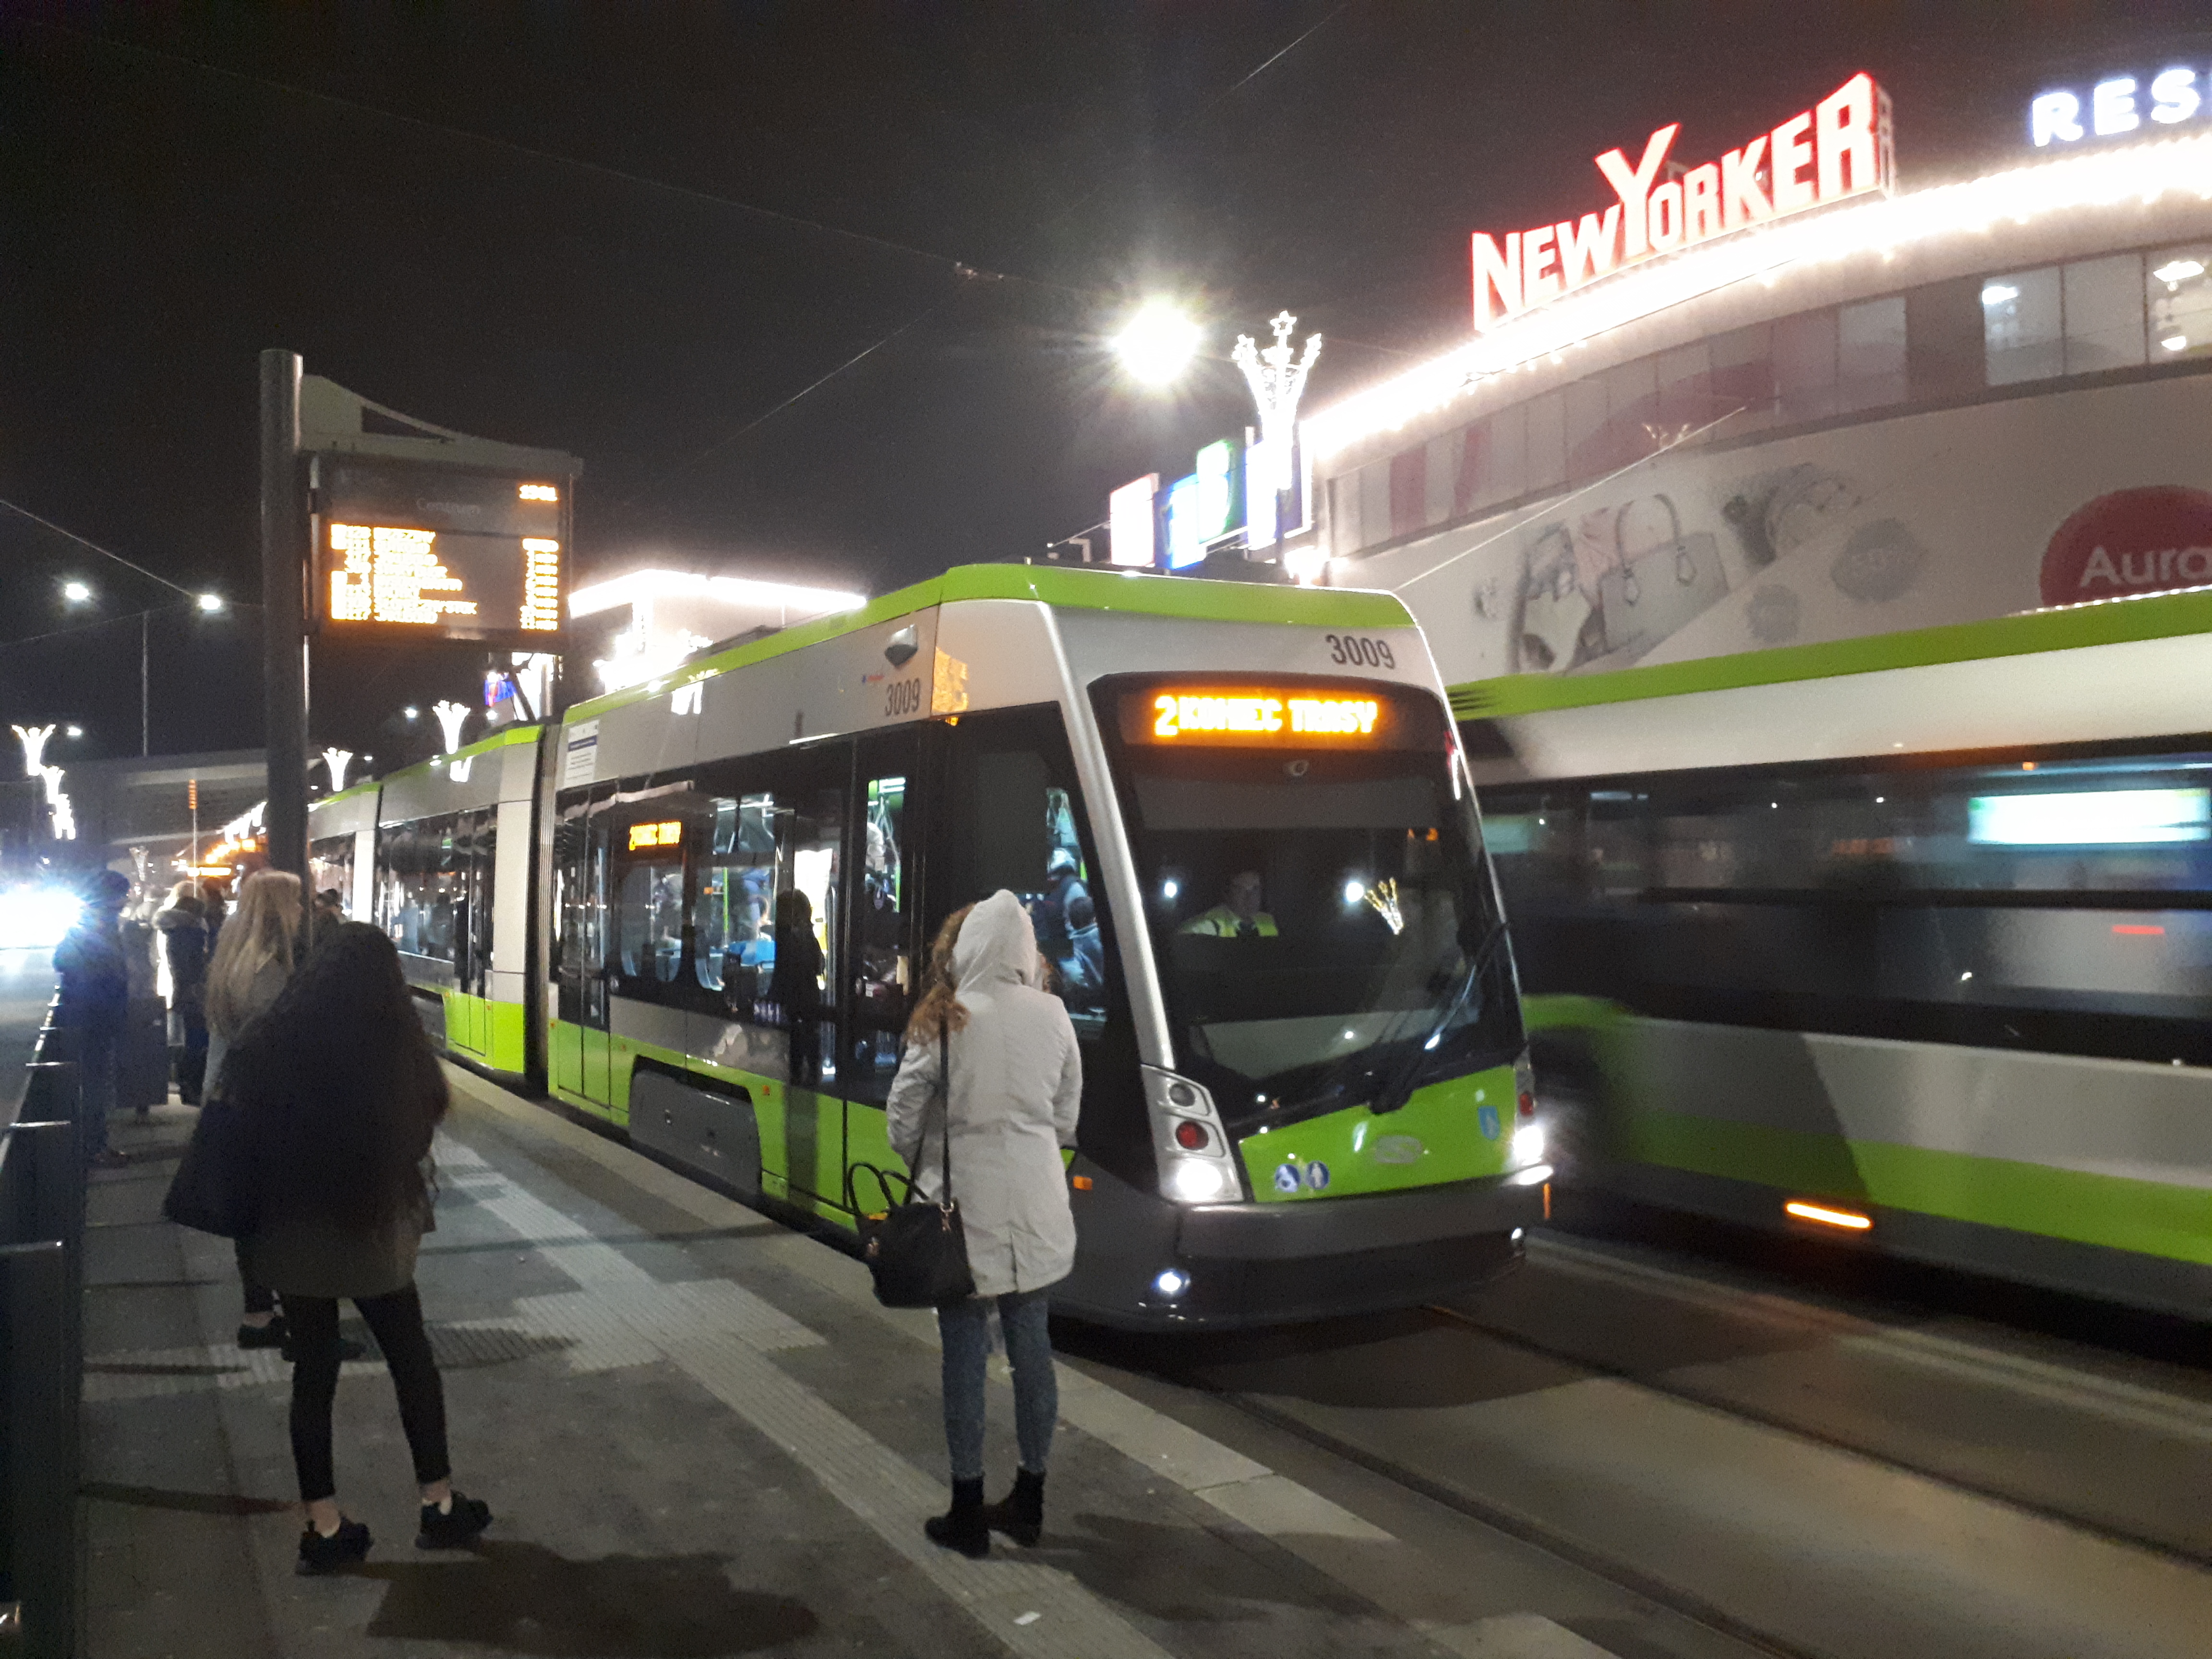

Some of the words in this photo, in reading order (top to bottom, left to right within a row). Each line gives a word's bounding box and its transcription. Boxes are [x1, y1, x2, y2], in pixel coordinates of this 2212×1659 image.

[2032, 68, 2212, 147] RES
[2079, 545, 2212, 589] Aura
[1324, 633, 1396, 670] 3009
[885, 677, 921, 717] 3009
[1154, 695, 1178, 737] 2
